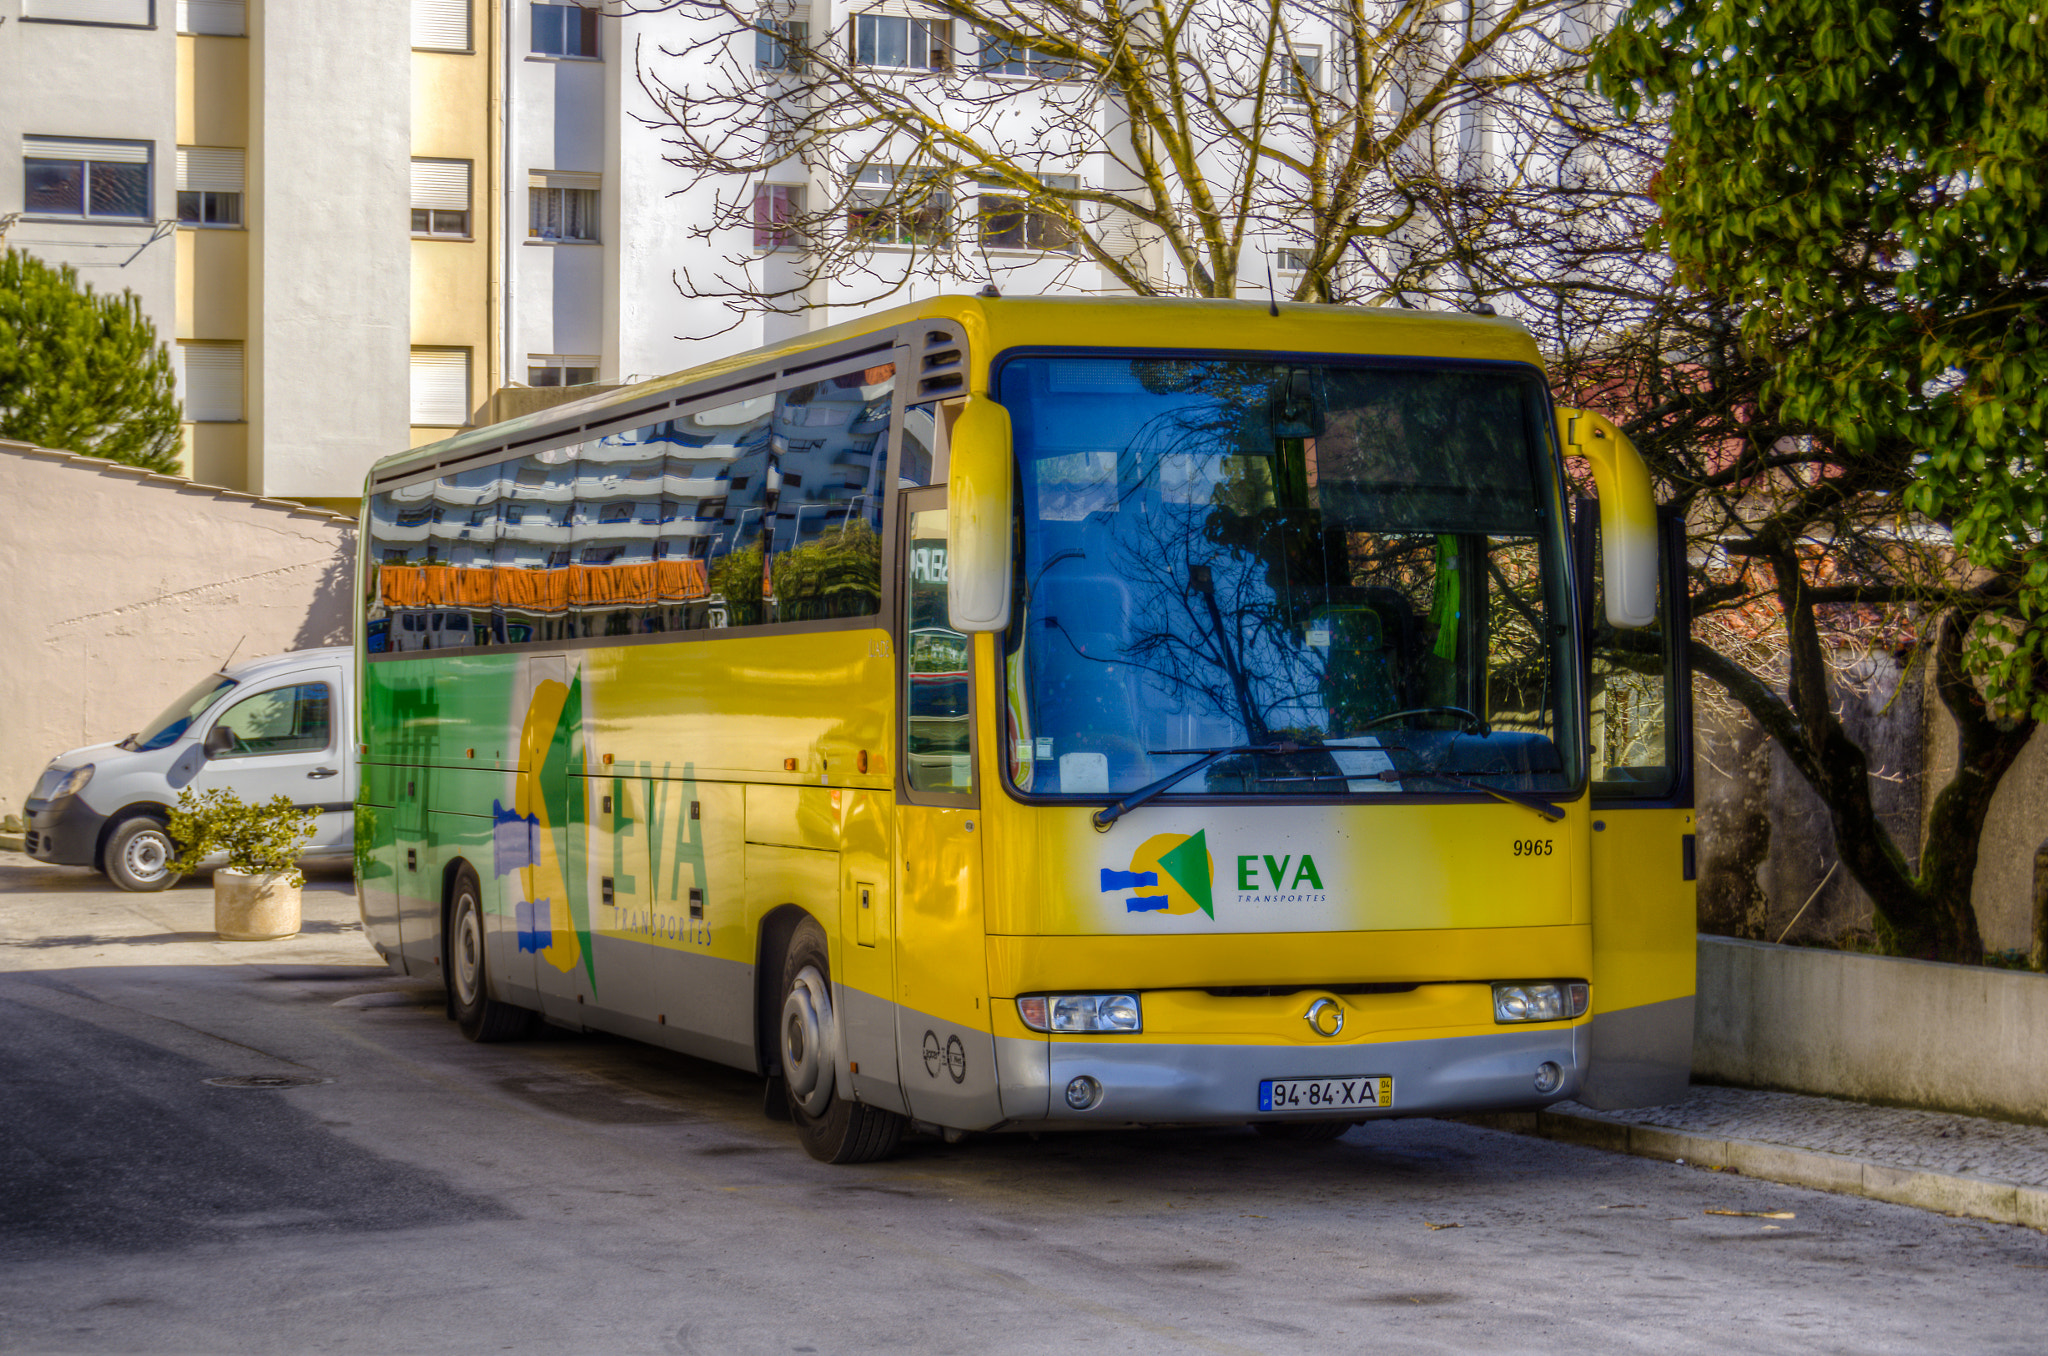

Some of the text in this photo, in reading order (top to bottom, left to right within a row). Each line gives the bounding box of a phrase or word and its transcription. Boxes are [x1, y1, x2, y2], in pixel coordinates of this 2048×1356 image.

[613, 760, 710, 906] EVA
[1513, 839, 1553, 856] 9965
[1237, 854, 1324, 892] EVA
[1238, 894, 1326, 903] TRANSPORTES
[614, 906, 712, 947] TRANSPORTES
[1381, 1081, 1390, 1089] 04
[1381, 1095, 1390, 1104] 02
